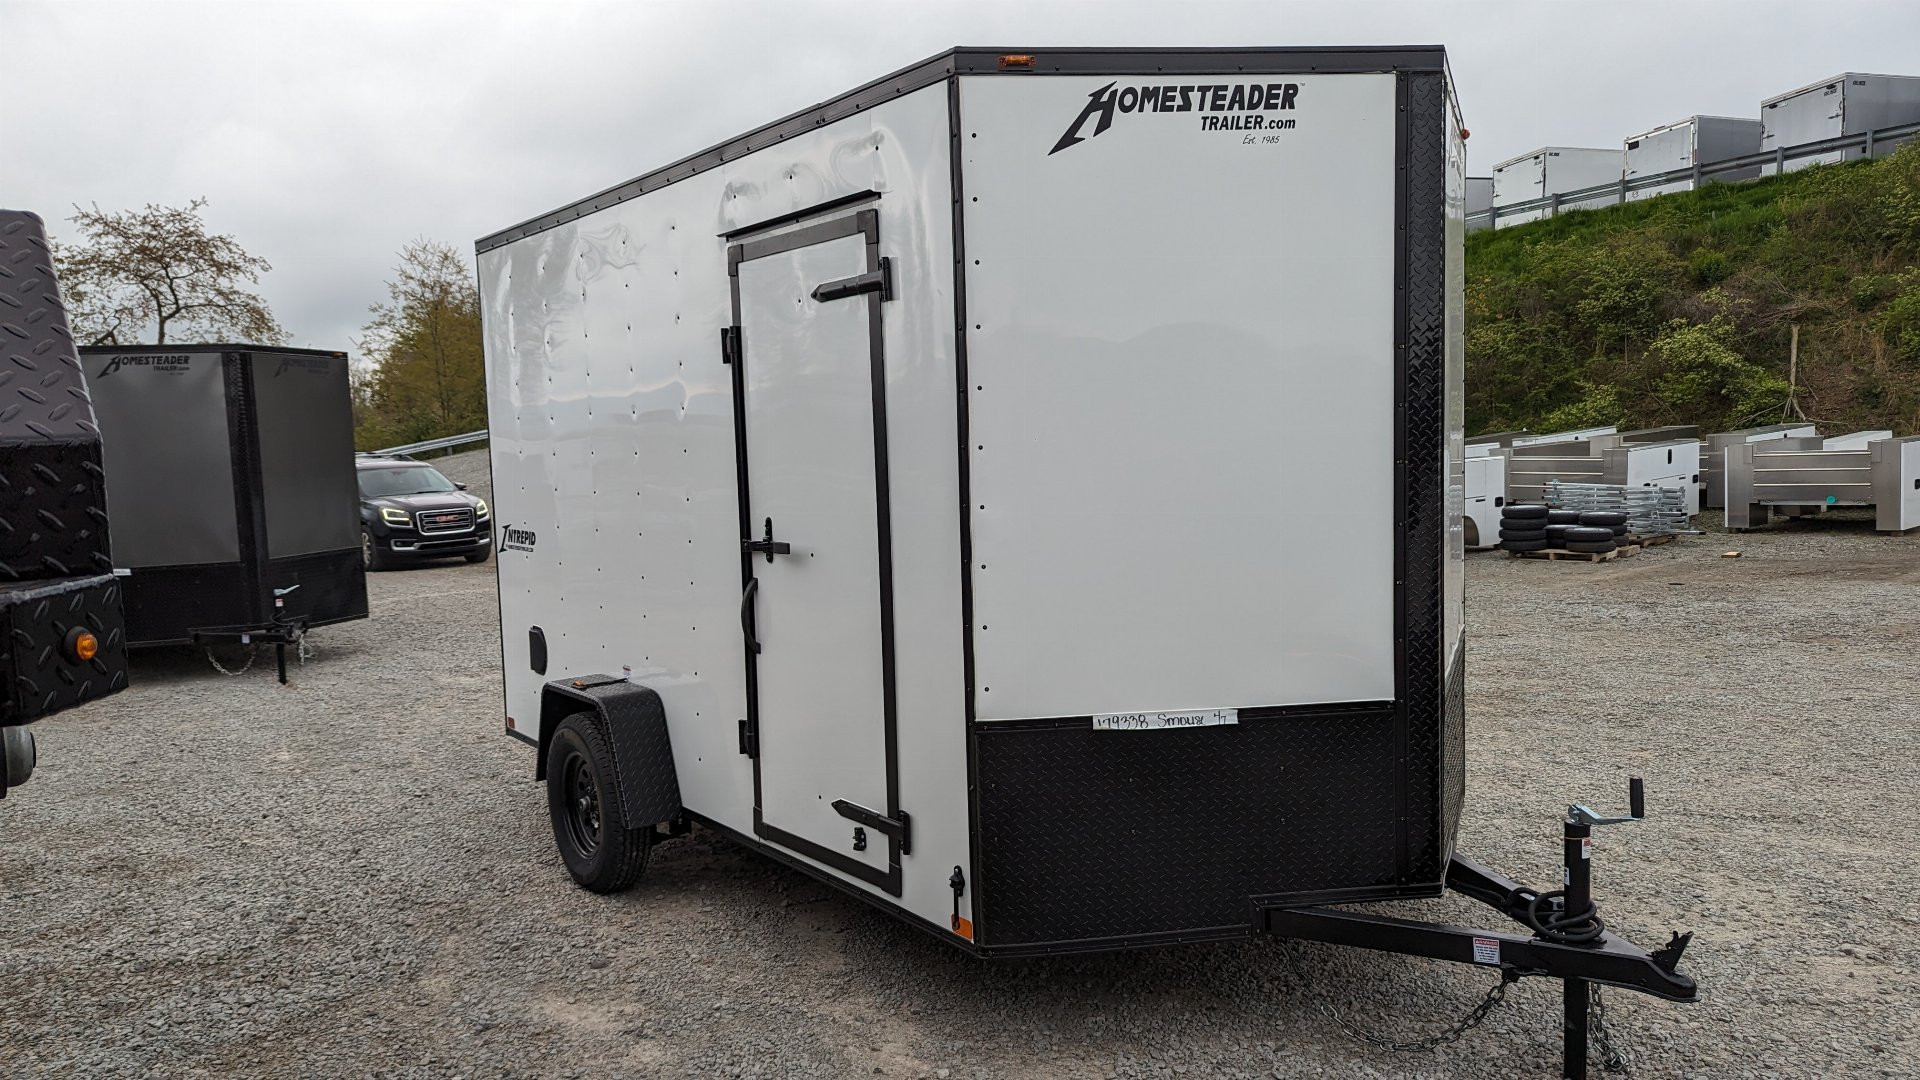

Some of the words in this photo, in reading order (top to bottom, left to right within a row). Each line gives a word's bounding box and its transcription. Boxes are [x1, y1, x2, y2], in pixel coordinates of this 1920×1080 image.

[1048, 80, 1299, 156] HOMESTEADER
[1201, 115, 1296, 131] TRAILER.com
[1261, 135, 1280, 144] 1985
[96, 355, 190, 379] HOMESTEADER
[499, 524, 536, 553] INTREPID
